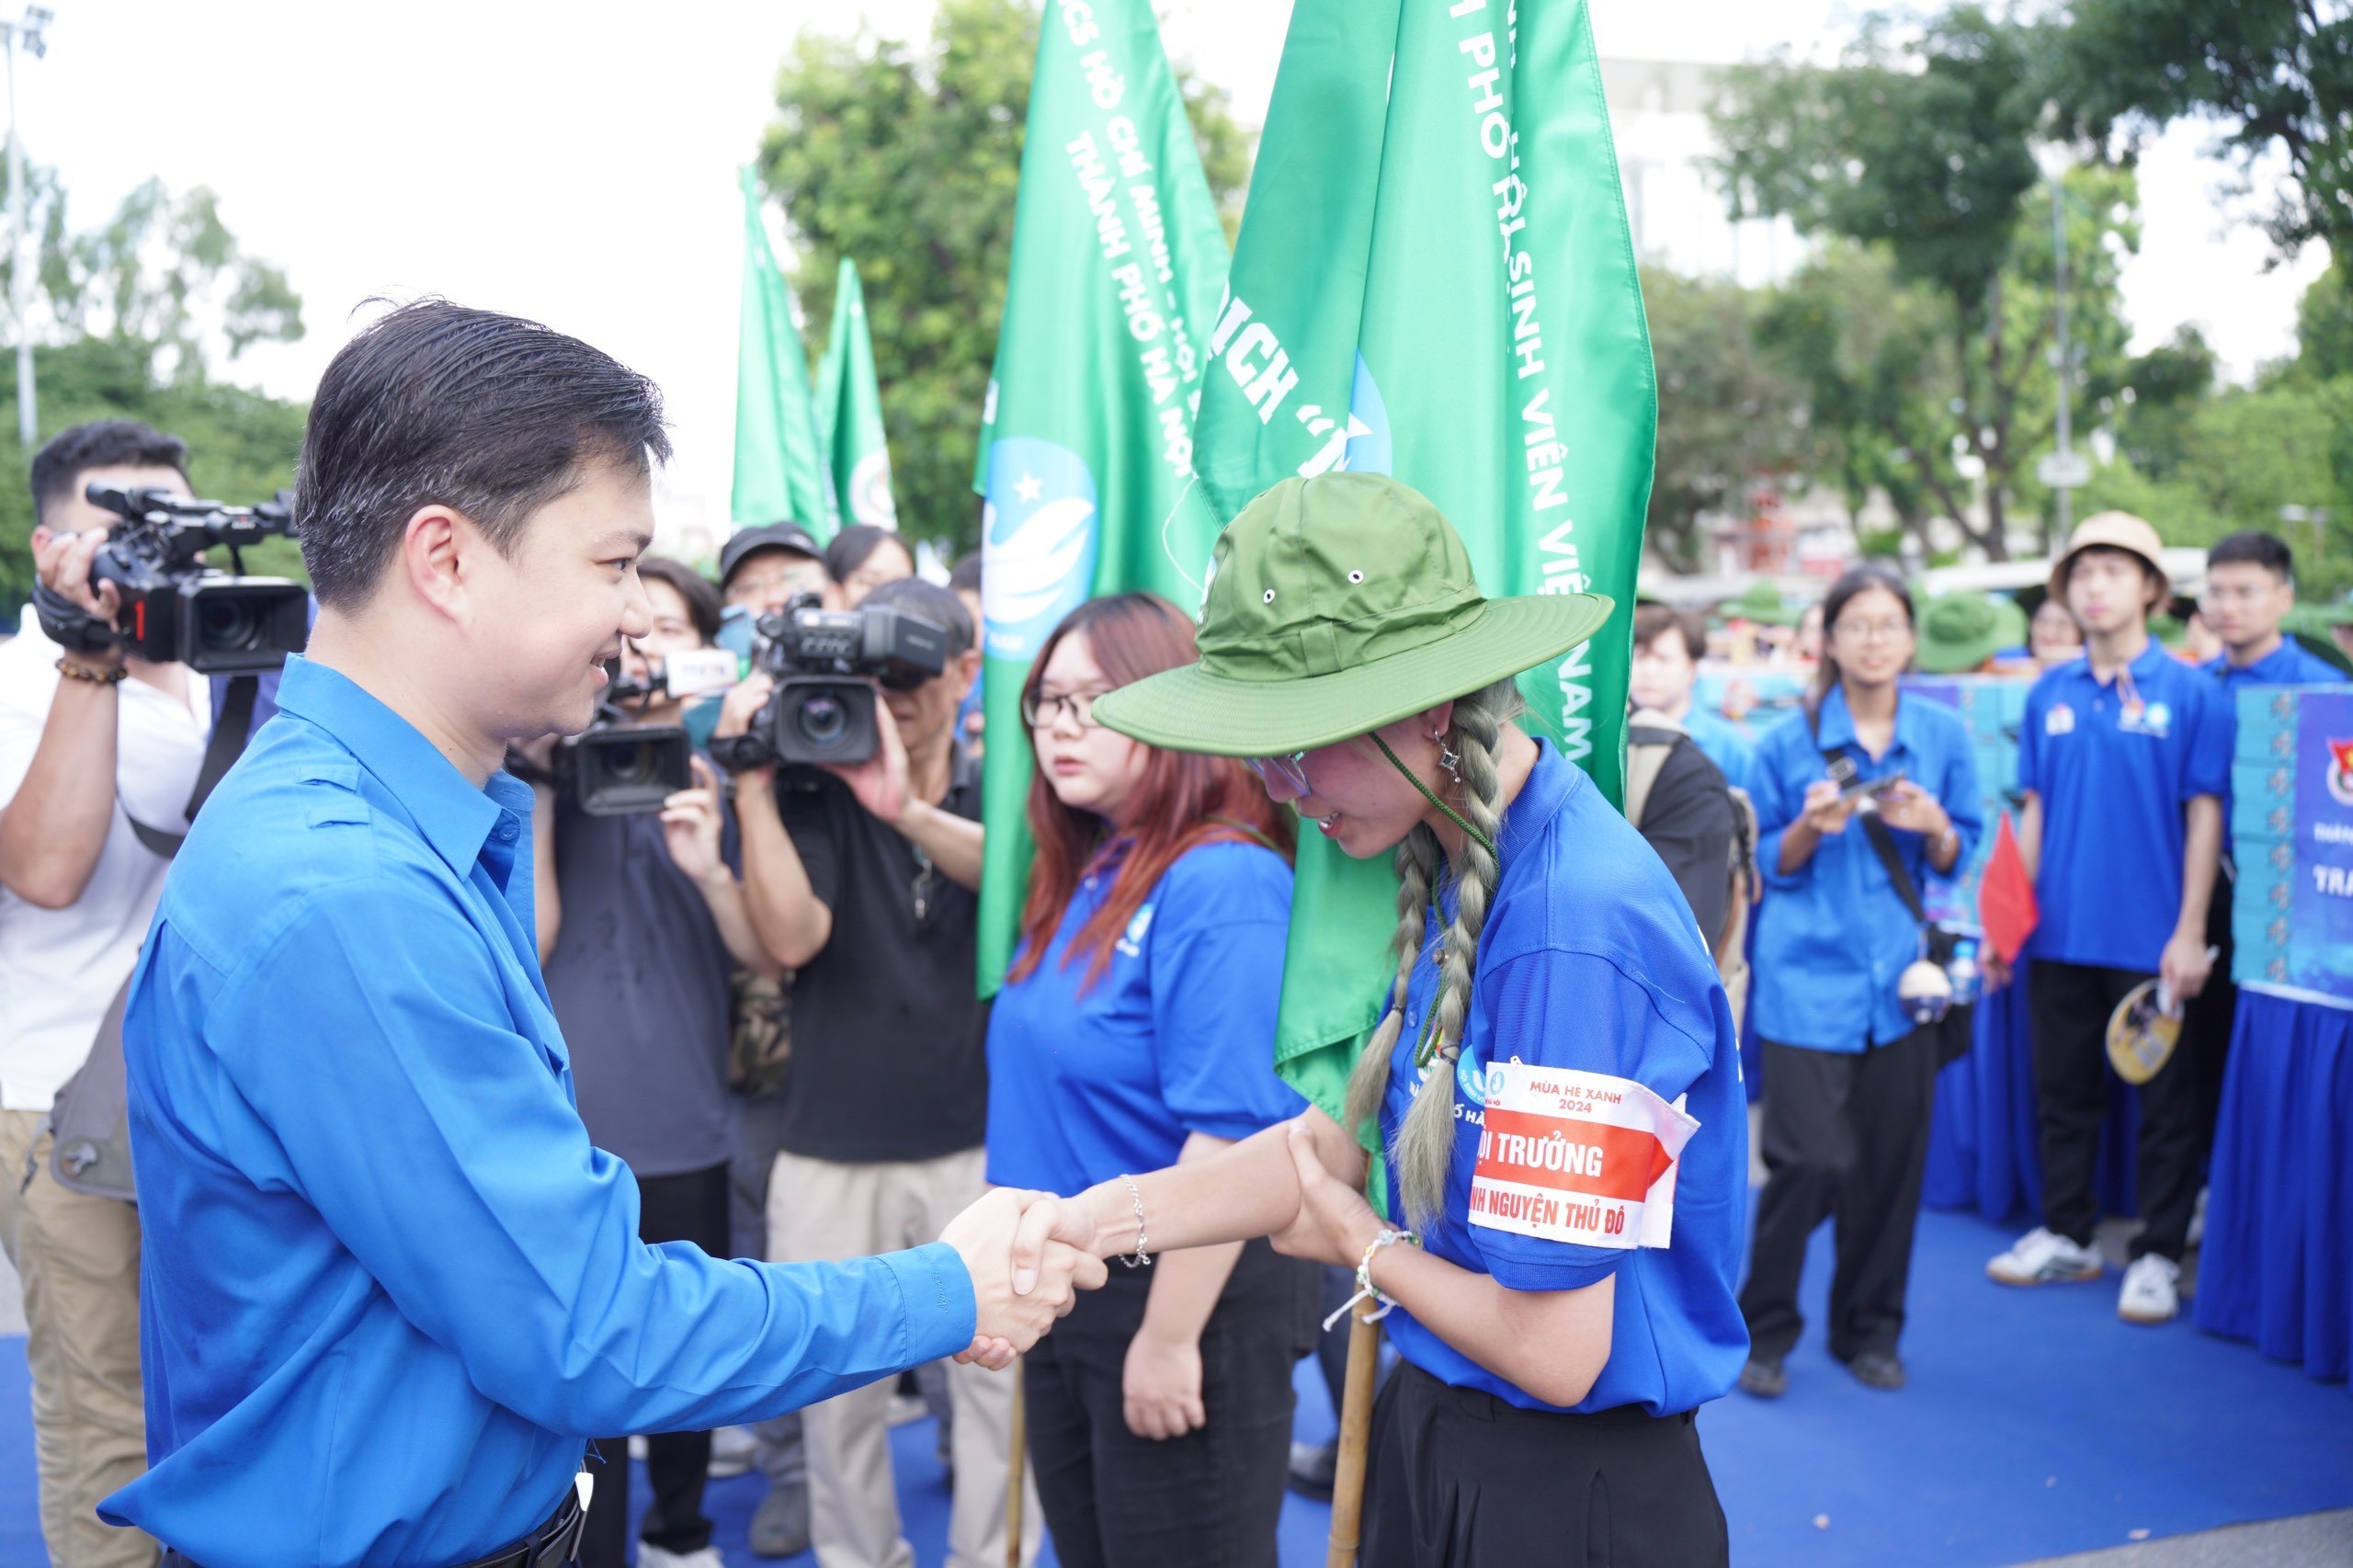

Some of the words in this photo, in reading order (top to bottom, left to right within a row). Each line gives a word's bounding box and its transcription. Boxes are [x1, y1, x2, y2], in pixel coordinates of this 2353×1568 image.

[1107, 115, 1154, 178] CHÍ
[1065, 130, 1132, 260] THÀNH
[1110, 262, 1167, 343] PHỐ
[1130, 184, 1174, 283] MINH
[1508, 251, 1545, 380] SINH
[1521, 387, 1569, 511] VIÊN
[1537, 518, 1592, 596] VIỆ
[1557, 638, 1593, 761] NAM
[1529, 1080, 1561, 1096] MÙA
[1564, 1085, 1582, 1098] HÈ
[1586, 1088, 1622, 1105] XANH
[1559, 1098, 1593, 1113] 2024
[1497, 1130, 1604, 1177] TRƯỞNG
[1488, 1189, 1560, 1229] NGUYỆN
[1565, 1199, 1601, 1233] THỦ
[1604, 1205, 1626, 1235] ĐÔ
